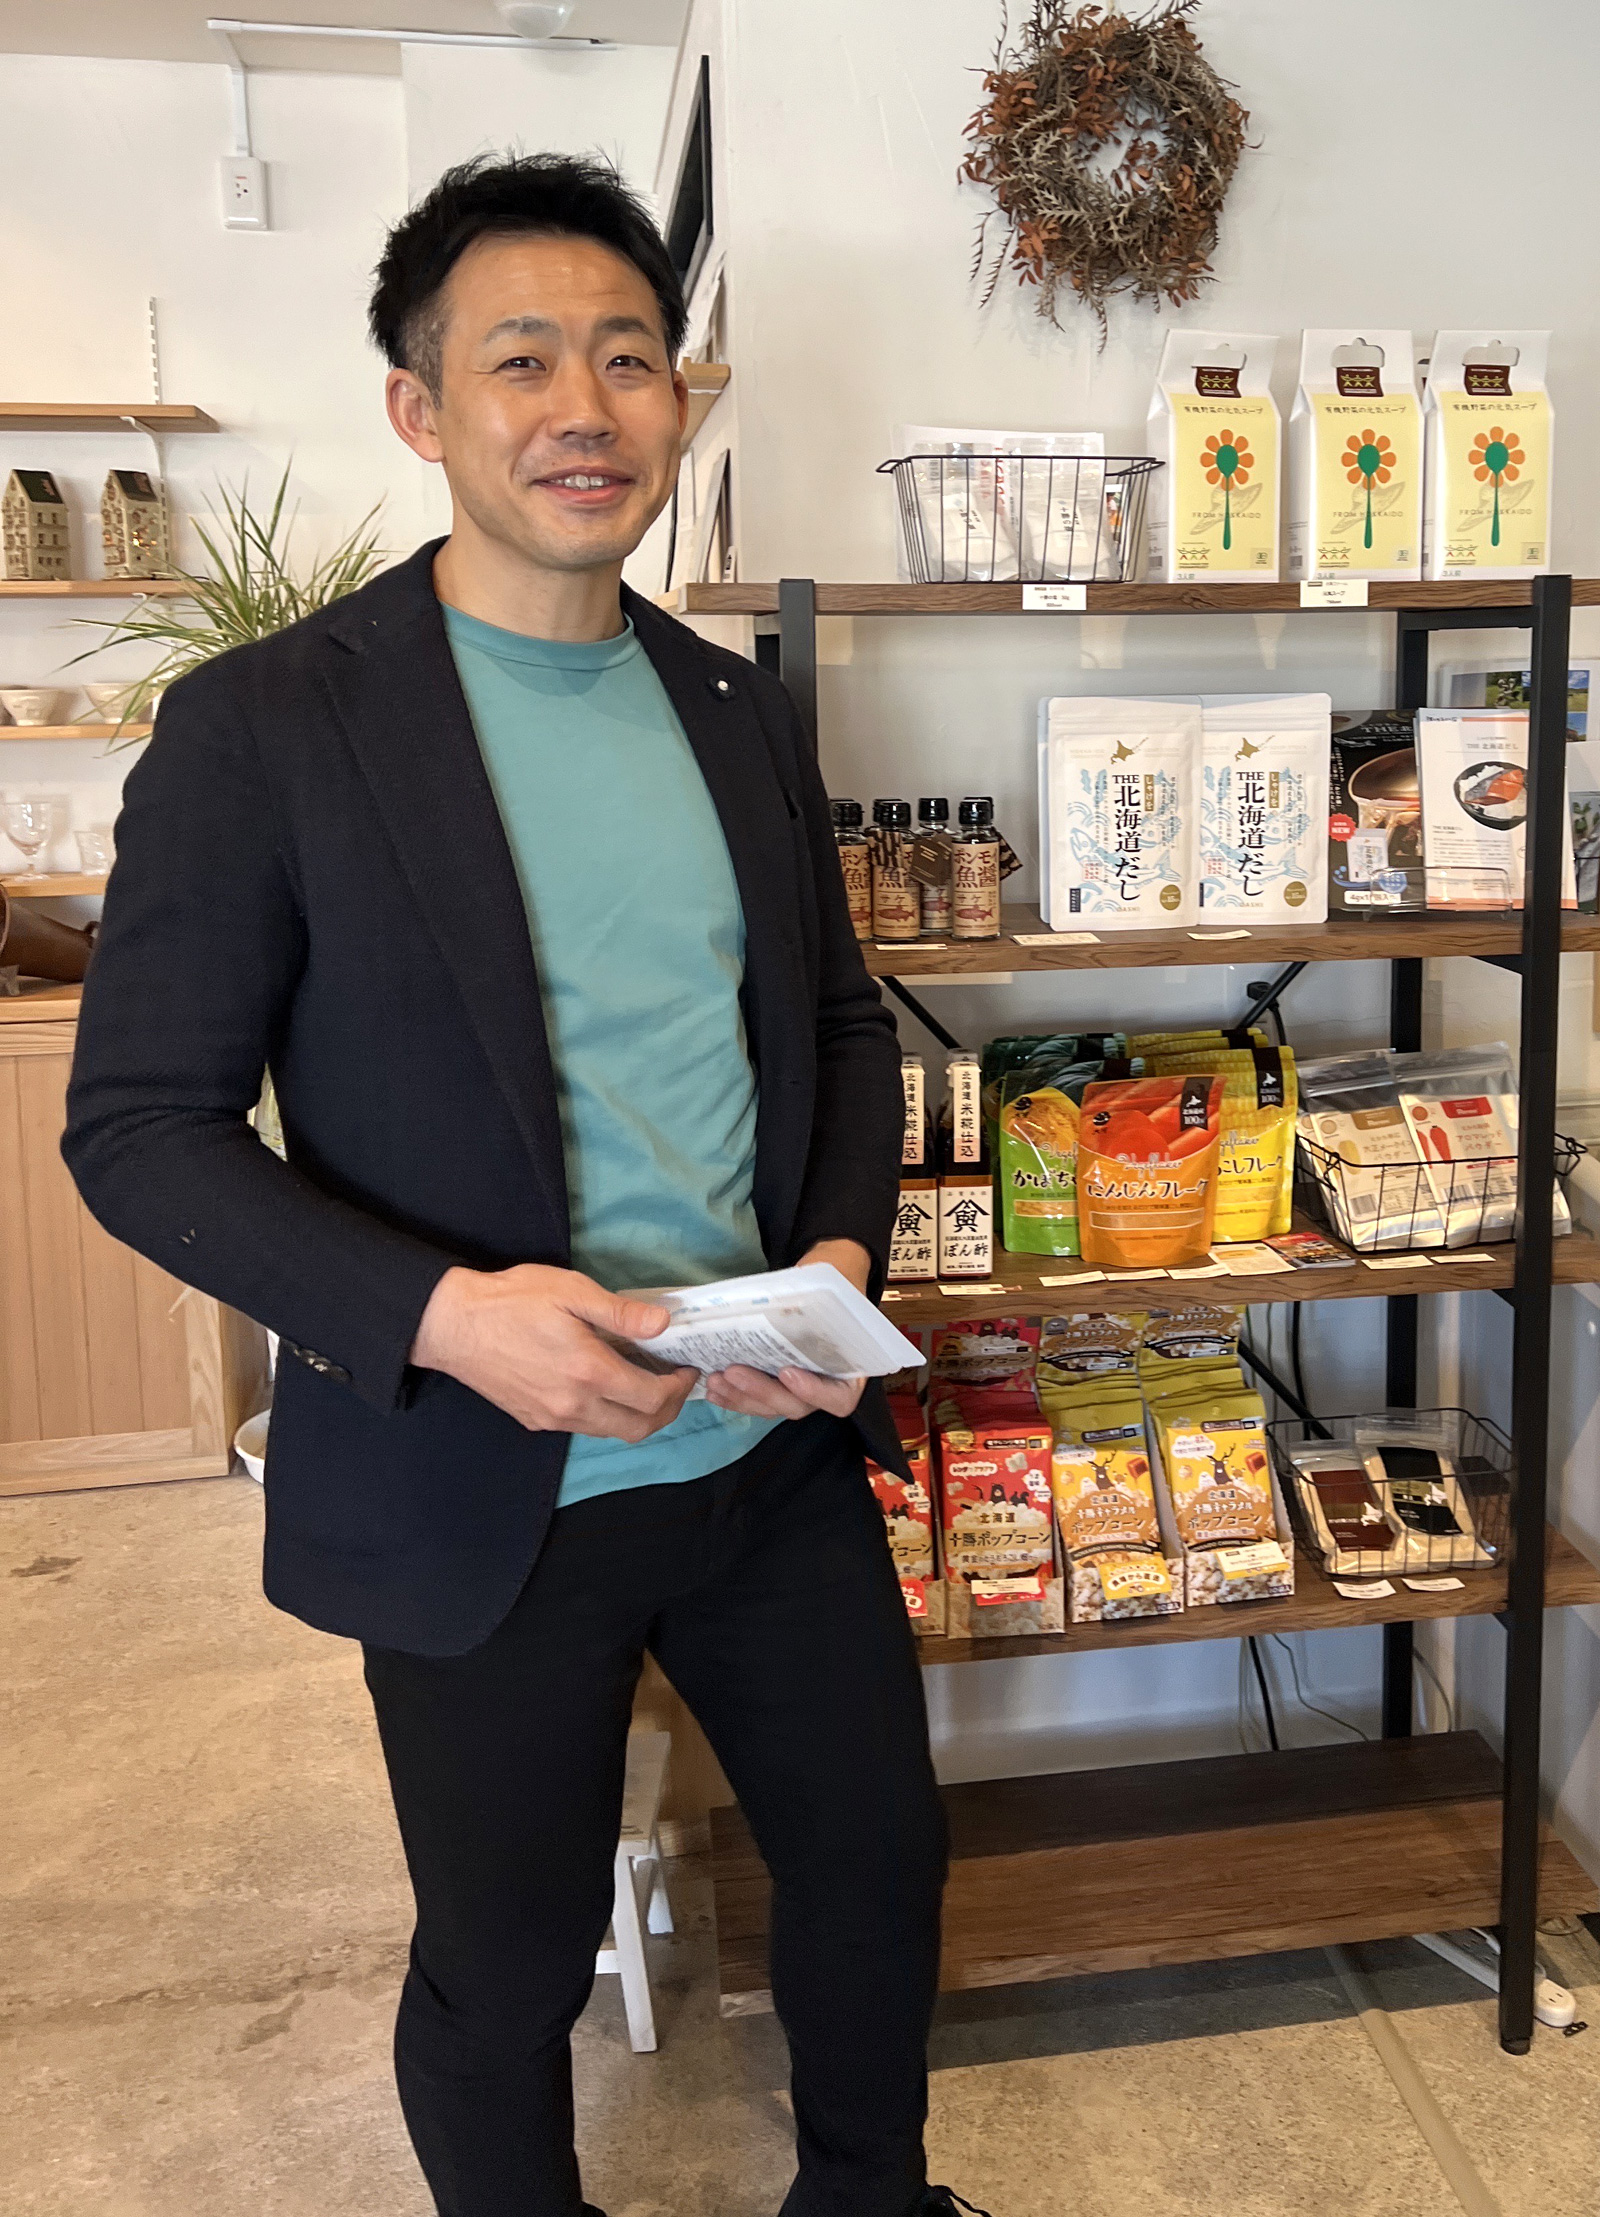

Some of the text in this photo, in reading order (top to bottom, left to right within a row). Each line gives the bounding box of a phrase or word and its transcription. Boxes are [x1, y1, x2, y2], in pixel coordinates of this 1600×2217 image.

[1112, 774, 1140, 784] THE
[1236, 771, 1265, 781] THE
[1114, 785, 1142, 901] 北海道だし
[1238, 782, 1266, 897] 北海道だし
[1087, 1180, 1209, 1199] にんじんフレーク
[944, 1242, 989, 1258] ぽん酢
[980, 1512, 1016, 1524] 北海道
[949, 1528, 1051, 1547] 十勝ポップコーン
